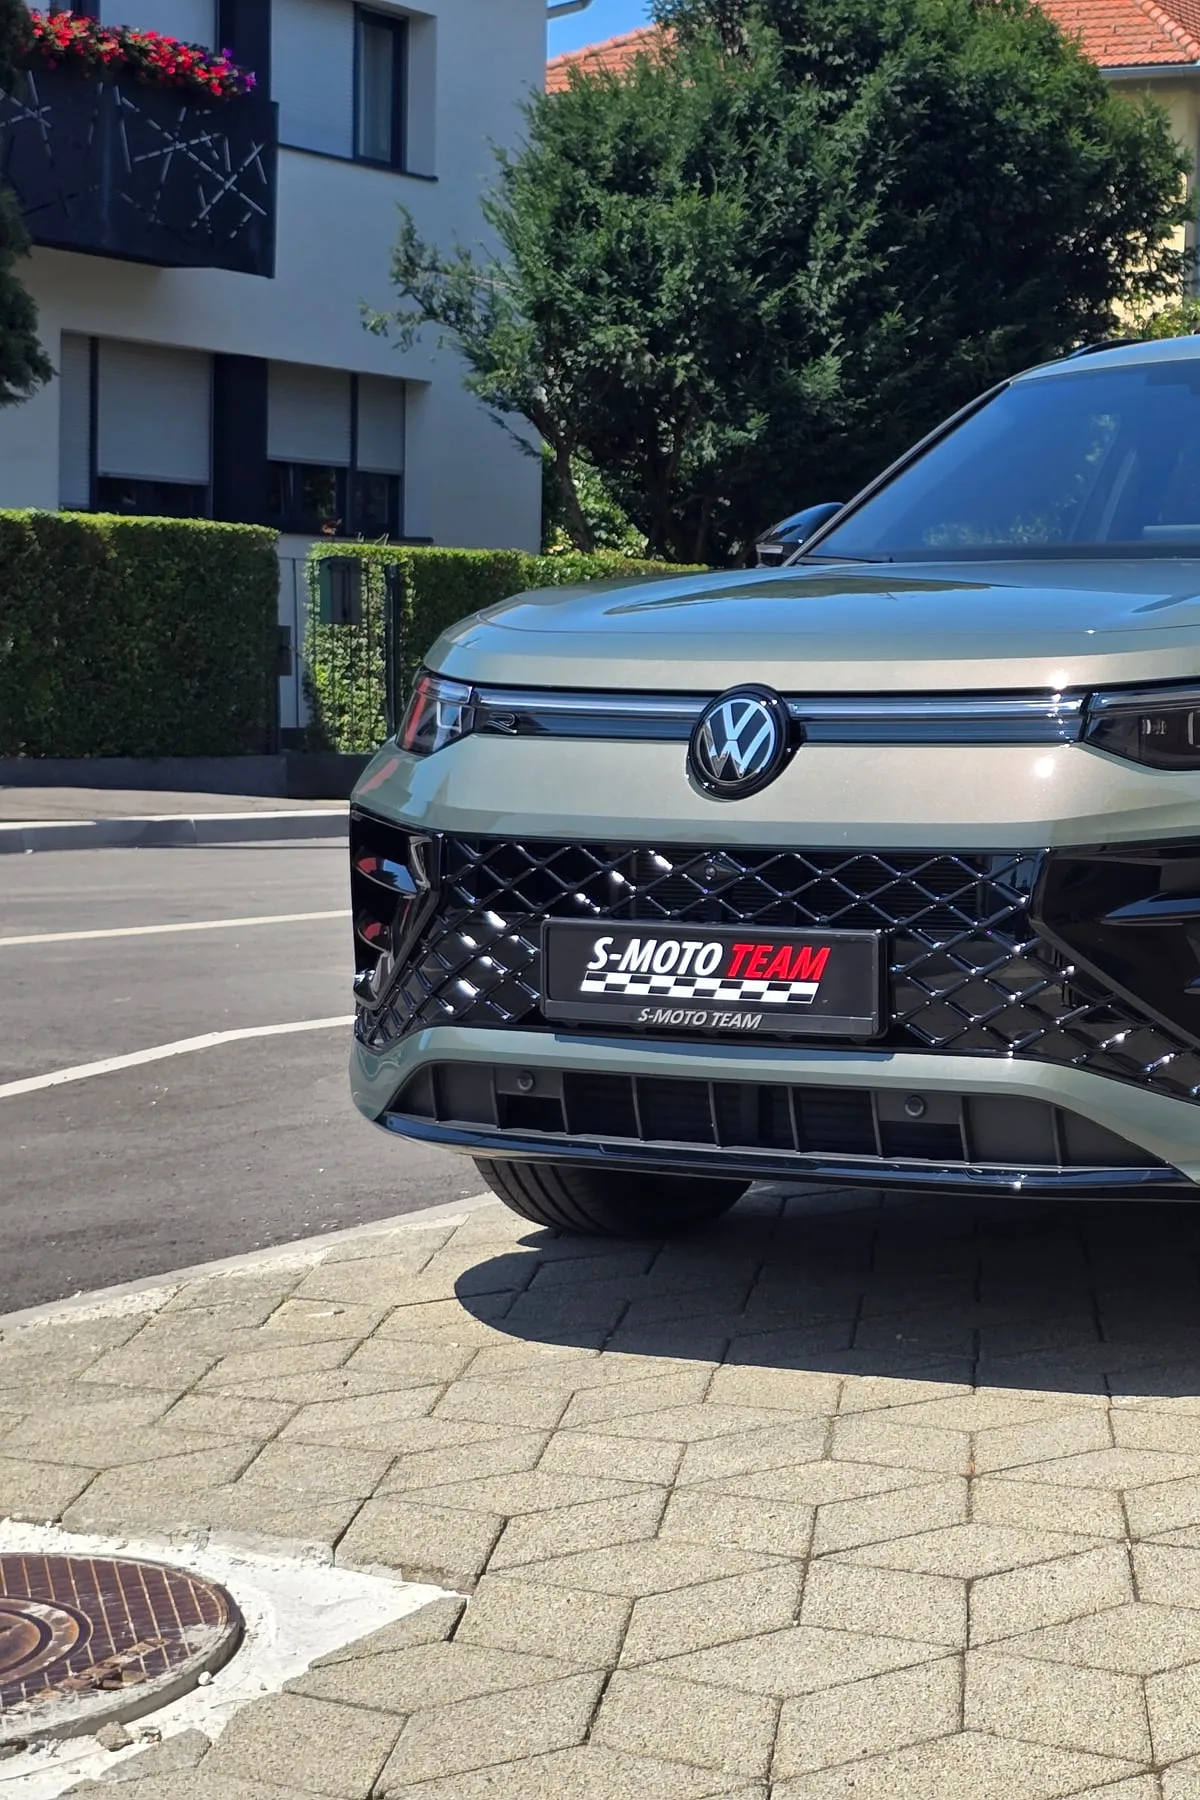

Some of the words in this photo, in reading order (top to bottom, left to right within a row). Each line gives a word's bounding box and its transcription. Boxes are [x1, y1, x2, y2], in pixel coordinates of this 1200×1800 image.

[698, 699, 775, 782] VW
[587, 936, 723, 976] S-MOTO
[727, 944, 831, 980] TEAM
[638, 1007, 708, 1026] S-MOTO
[711, 1012, 763, 1029] TEAM
